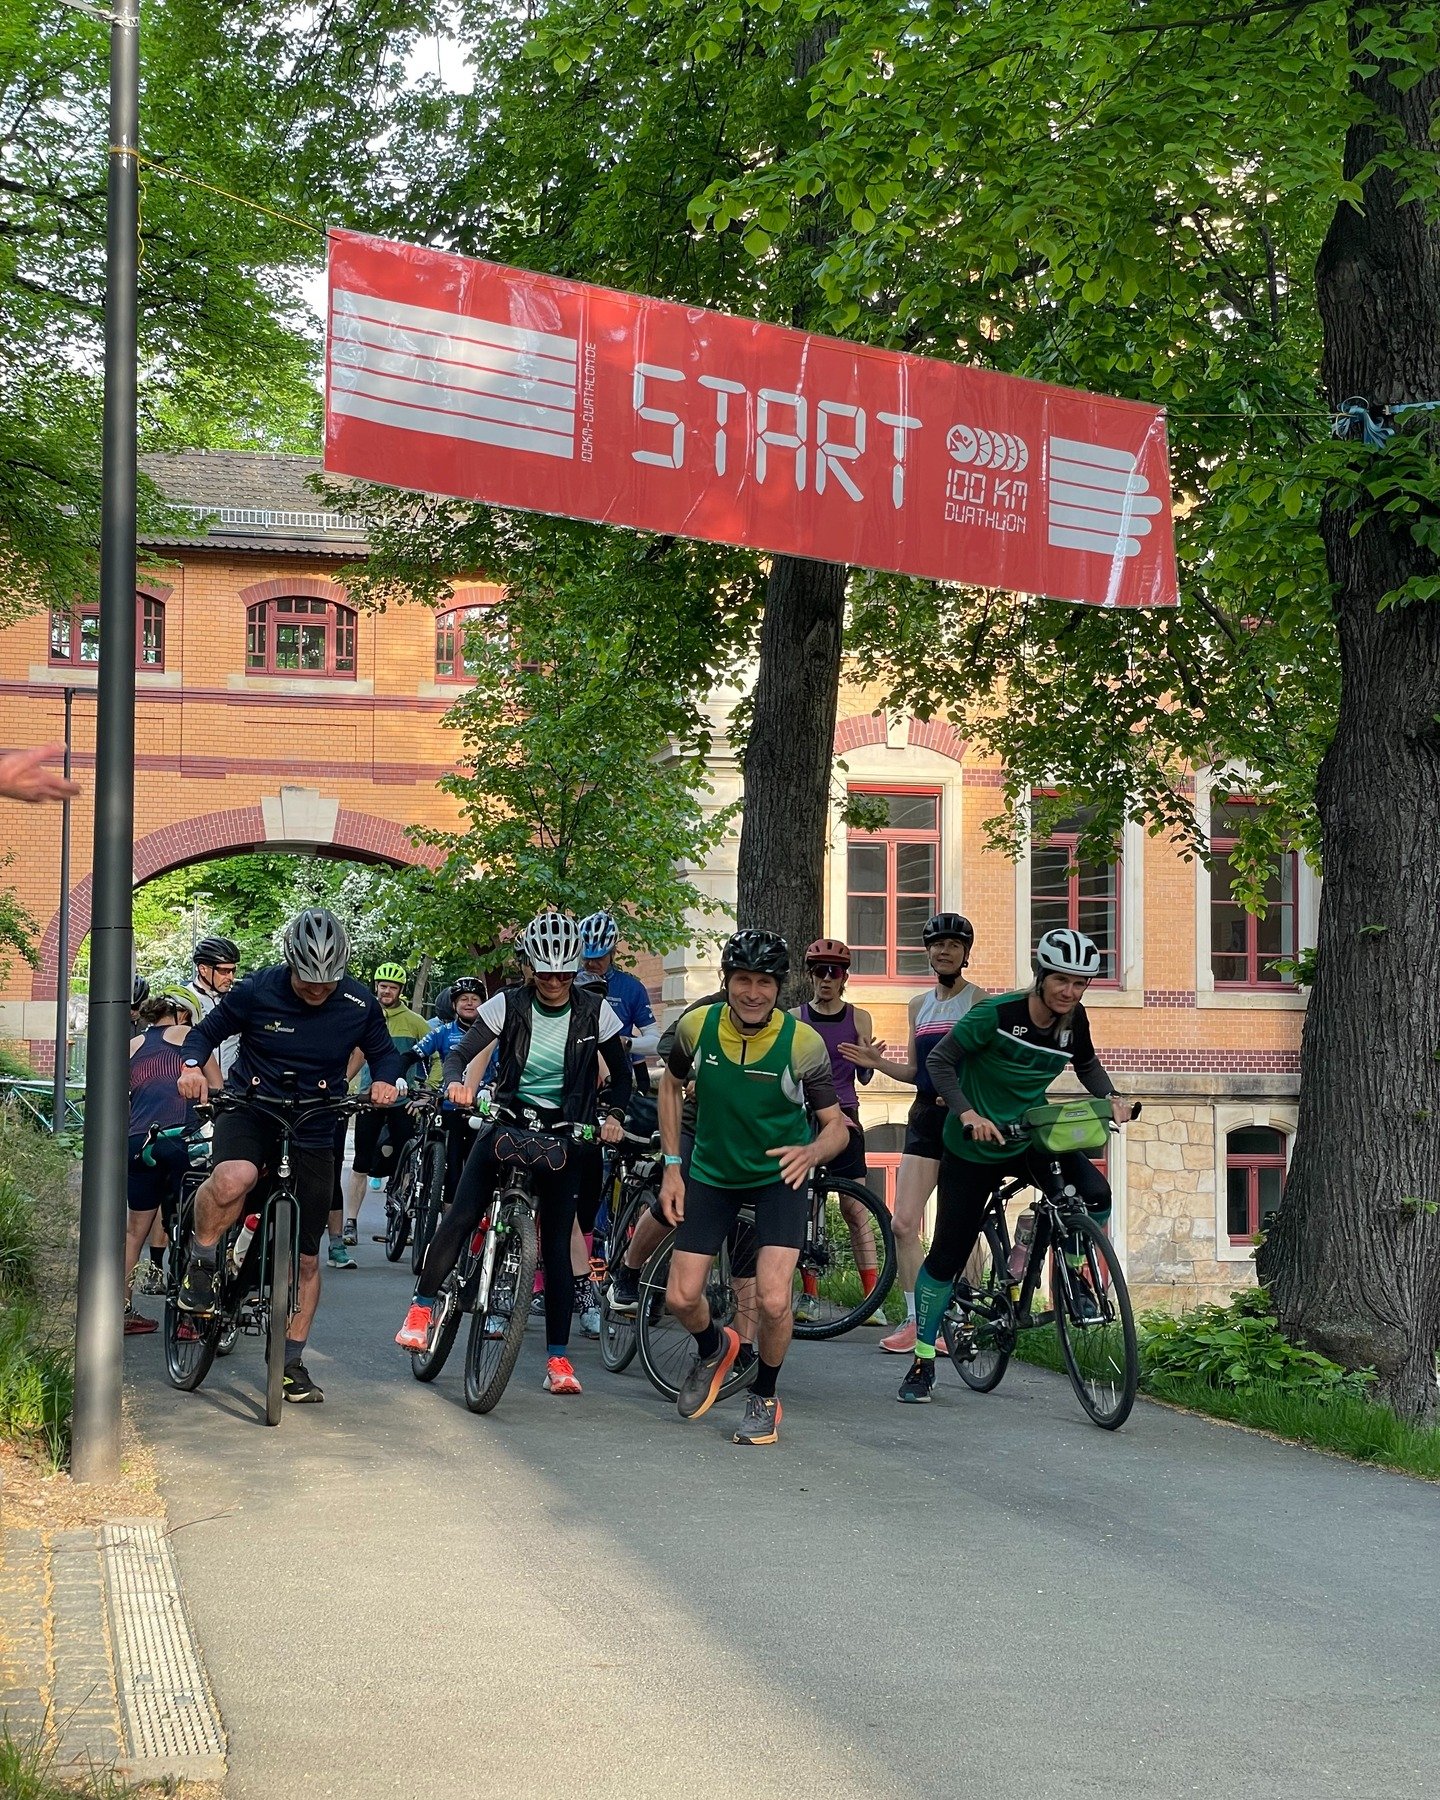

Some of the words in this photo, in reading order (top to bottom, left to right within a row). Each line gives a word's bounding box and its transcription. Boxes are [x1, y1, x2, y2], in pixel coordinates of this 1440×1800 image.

[632, 363, 923, 509] START
[945, 468, 986, 504] 100
[993, 477, 1028, 512] KM
[945, 501, 1027, 534] DUATHLON
[1012, 1025, 1028, 1036] BP
